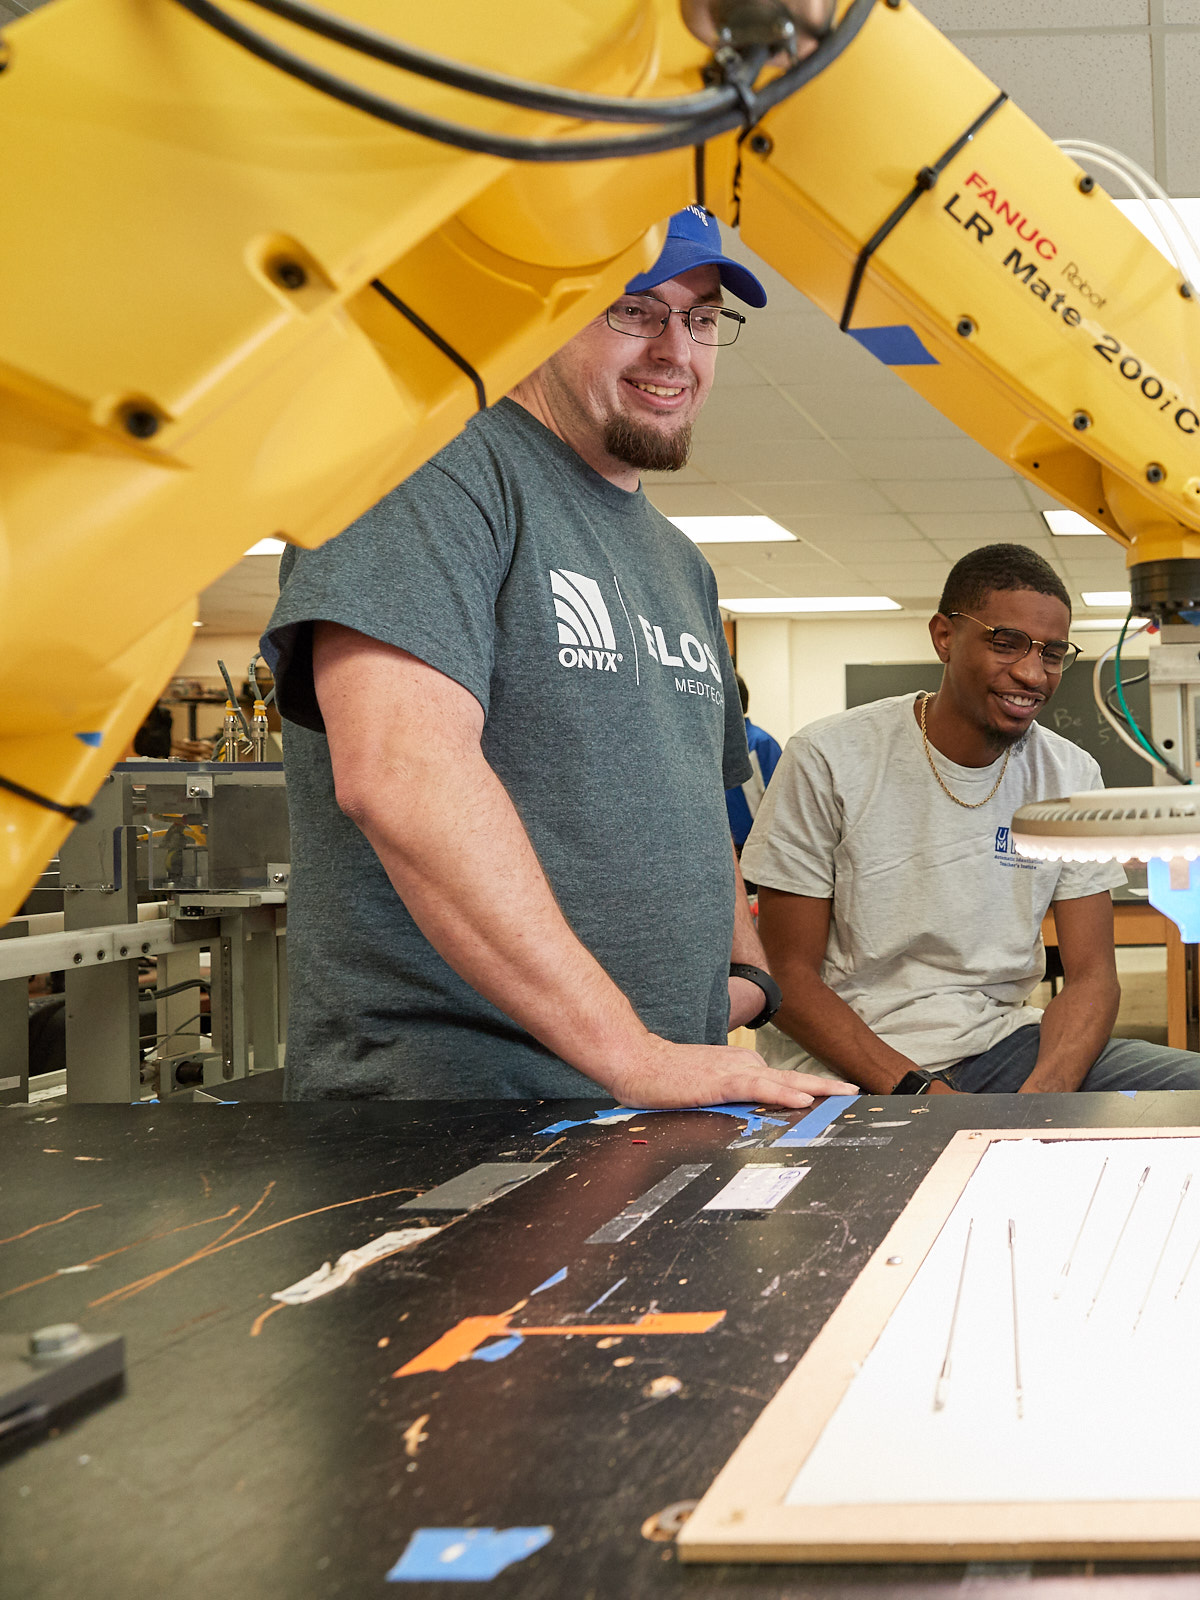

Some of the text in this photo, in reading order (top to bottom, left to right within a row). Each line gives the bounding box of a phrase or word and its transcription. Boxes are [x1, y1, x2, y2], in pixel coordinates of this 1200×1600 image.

[943, 193, 1200, 435] LR Mate 200iC
[964, 171, 1108, 310] FANUC Robot
